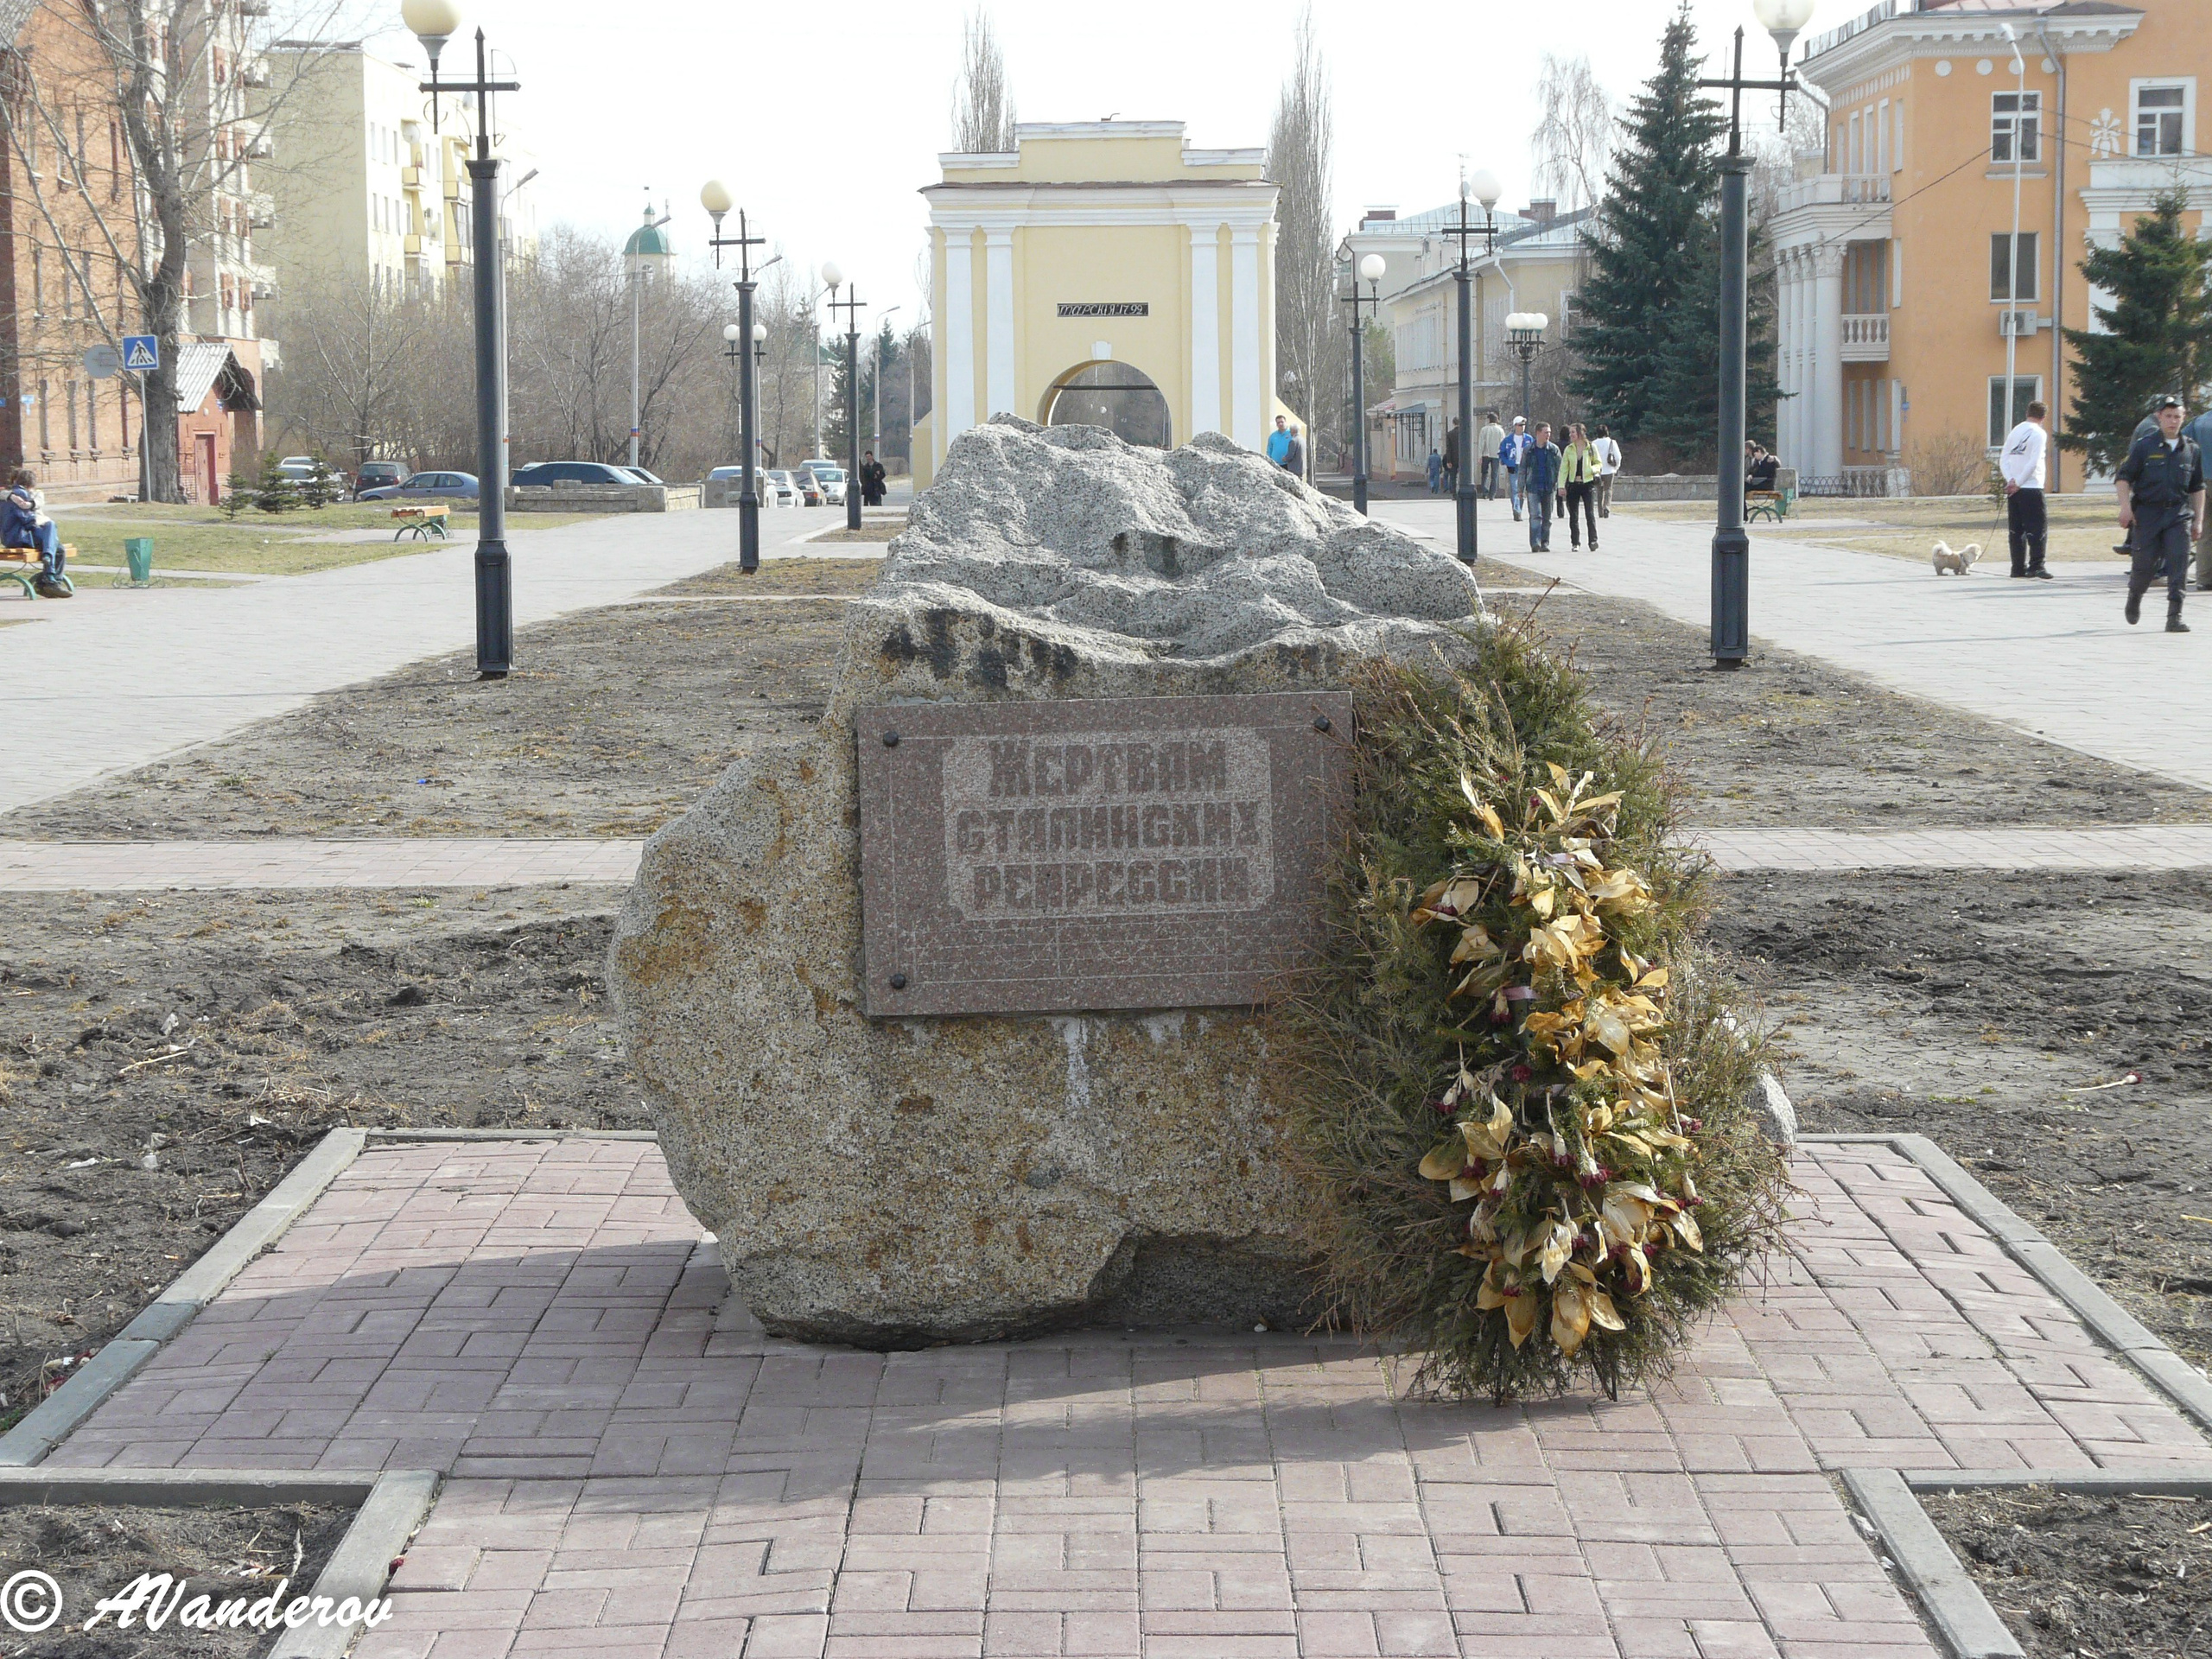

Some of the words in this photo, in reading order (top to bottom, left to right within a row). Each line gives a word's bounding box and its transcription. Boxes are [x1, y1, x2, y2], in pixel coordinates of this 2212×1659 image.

[1119, 303, 1143, 315] 1792
[989, 740, 1227, 798] ЖЕРТВАМ
[956, 801, 1262, 854] СТАЛИНСКИХ
